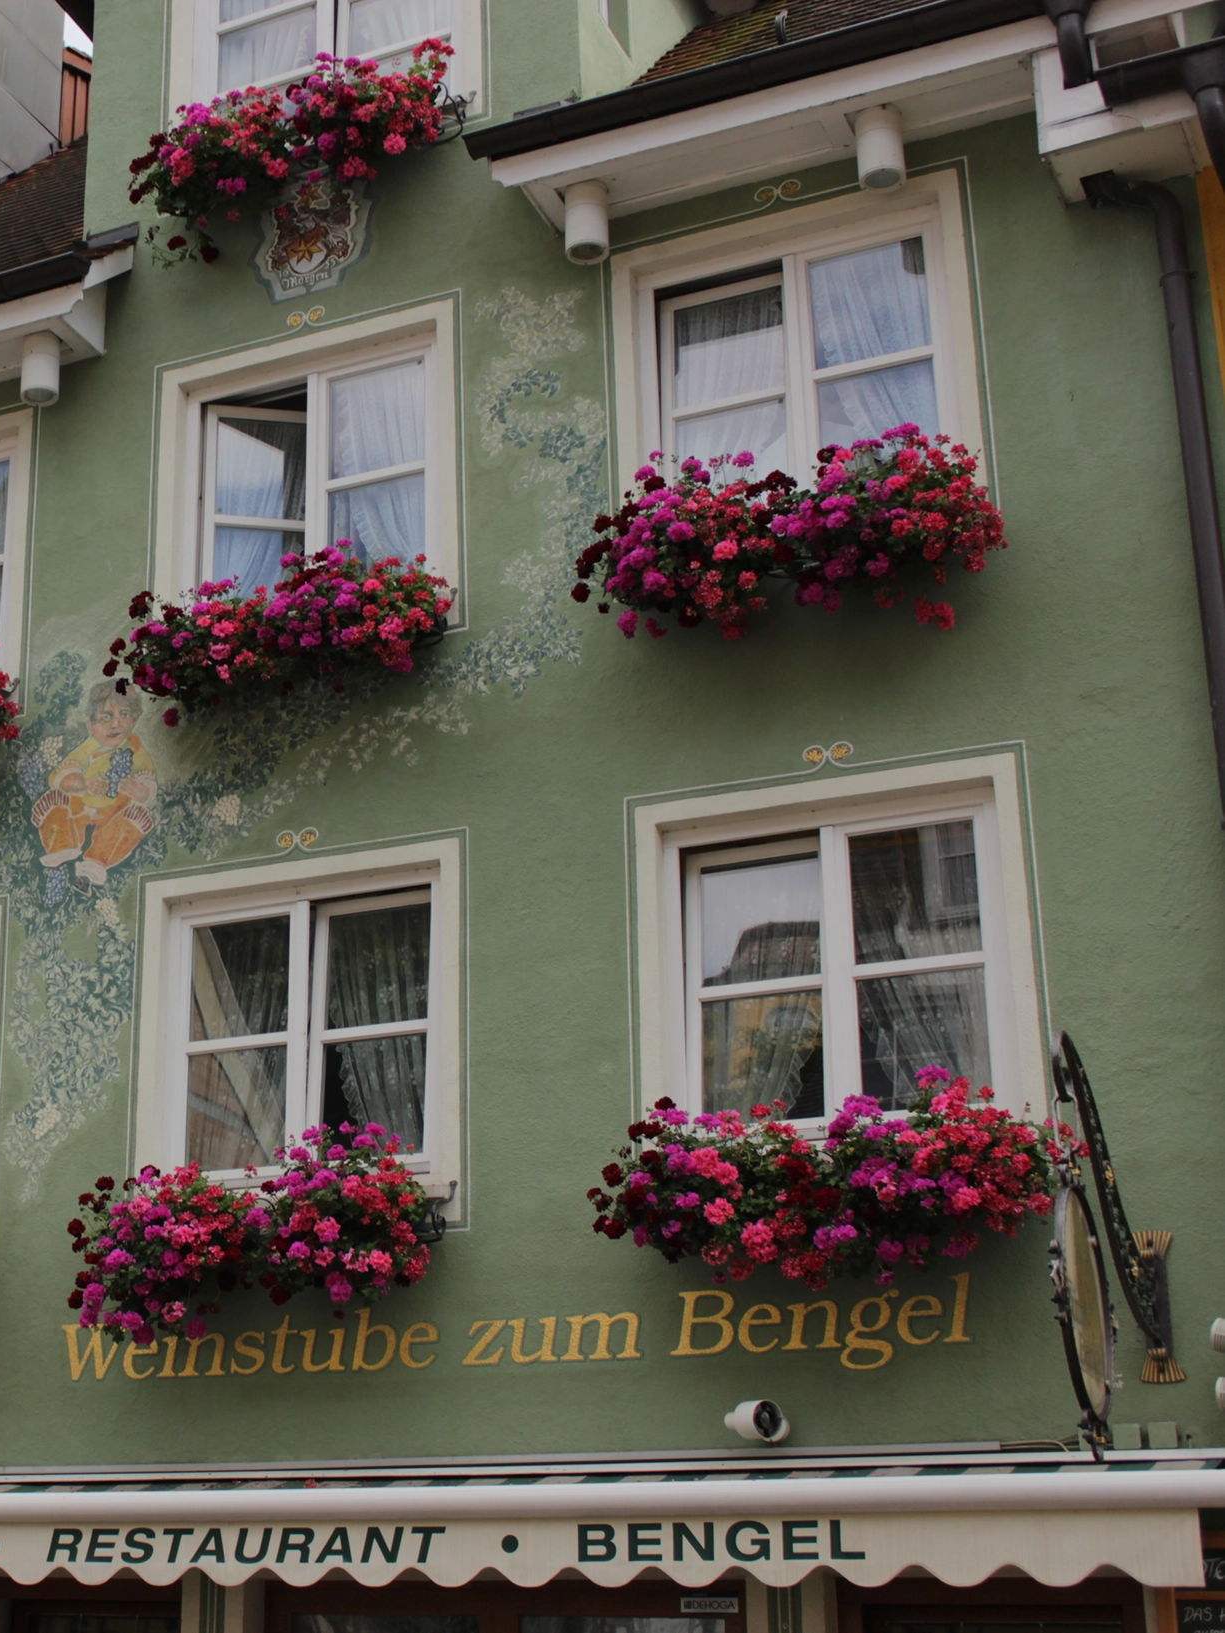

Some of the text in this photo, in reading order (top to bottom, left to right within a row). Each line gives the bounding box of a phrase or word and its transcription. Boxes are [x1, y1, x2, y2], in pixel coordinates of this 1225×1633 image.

[62, 1271, 972, 1381] Weinstube zum Bengel
[46, 1526, 446, 1564] RESTAURANT
[577, 1519, 866, 1562] BENGEL
[692, 1600, 735, 1610] DEHOGA
[1183, 1606, 1213, 1623] DAS
